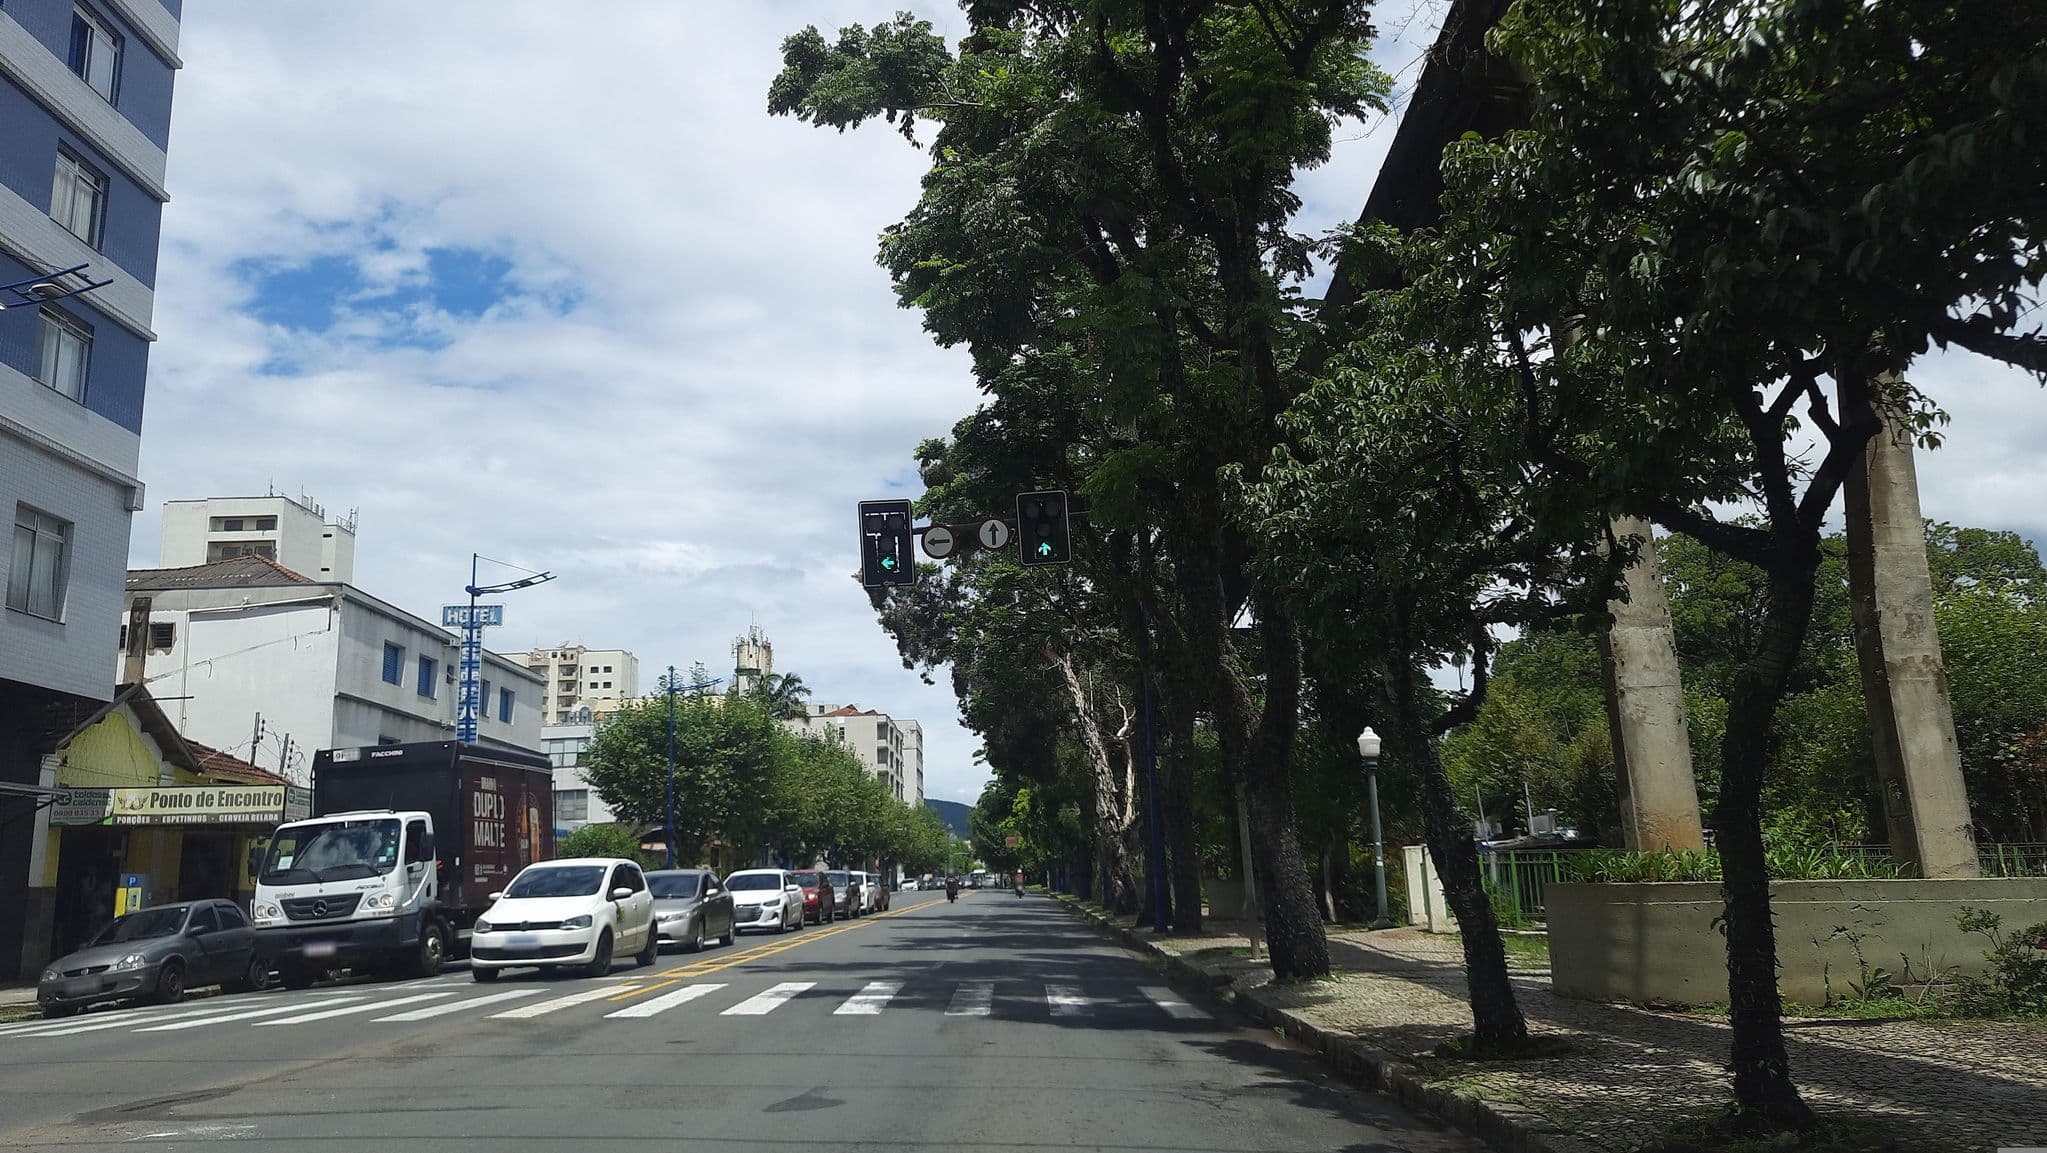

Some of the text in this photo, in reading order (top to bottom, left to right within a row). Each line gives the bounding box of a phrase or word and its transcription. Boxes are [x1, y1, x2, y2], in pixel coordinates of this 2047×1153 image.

[149, 792, 193, 809] Ponto
[196, 792, 215, 807] de
[217, 790, 283, 807] Encontro
[473, 791, 505, 820] DUPLO
[162, 814, 207, 824] ESPETINHOS
[219, 814, 249, 823] CERVEJA
[250, 813, 279, 822] GELADA
[474, 821, 505, 848] MALTE
